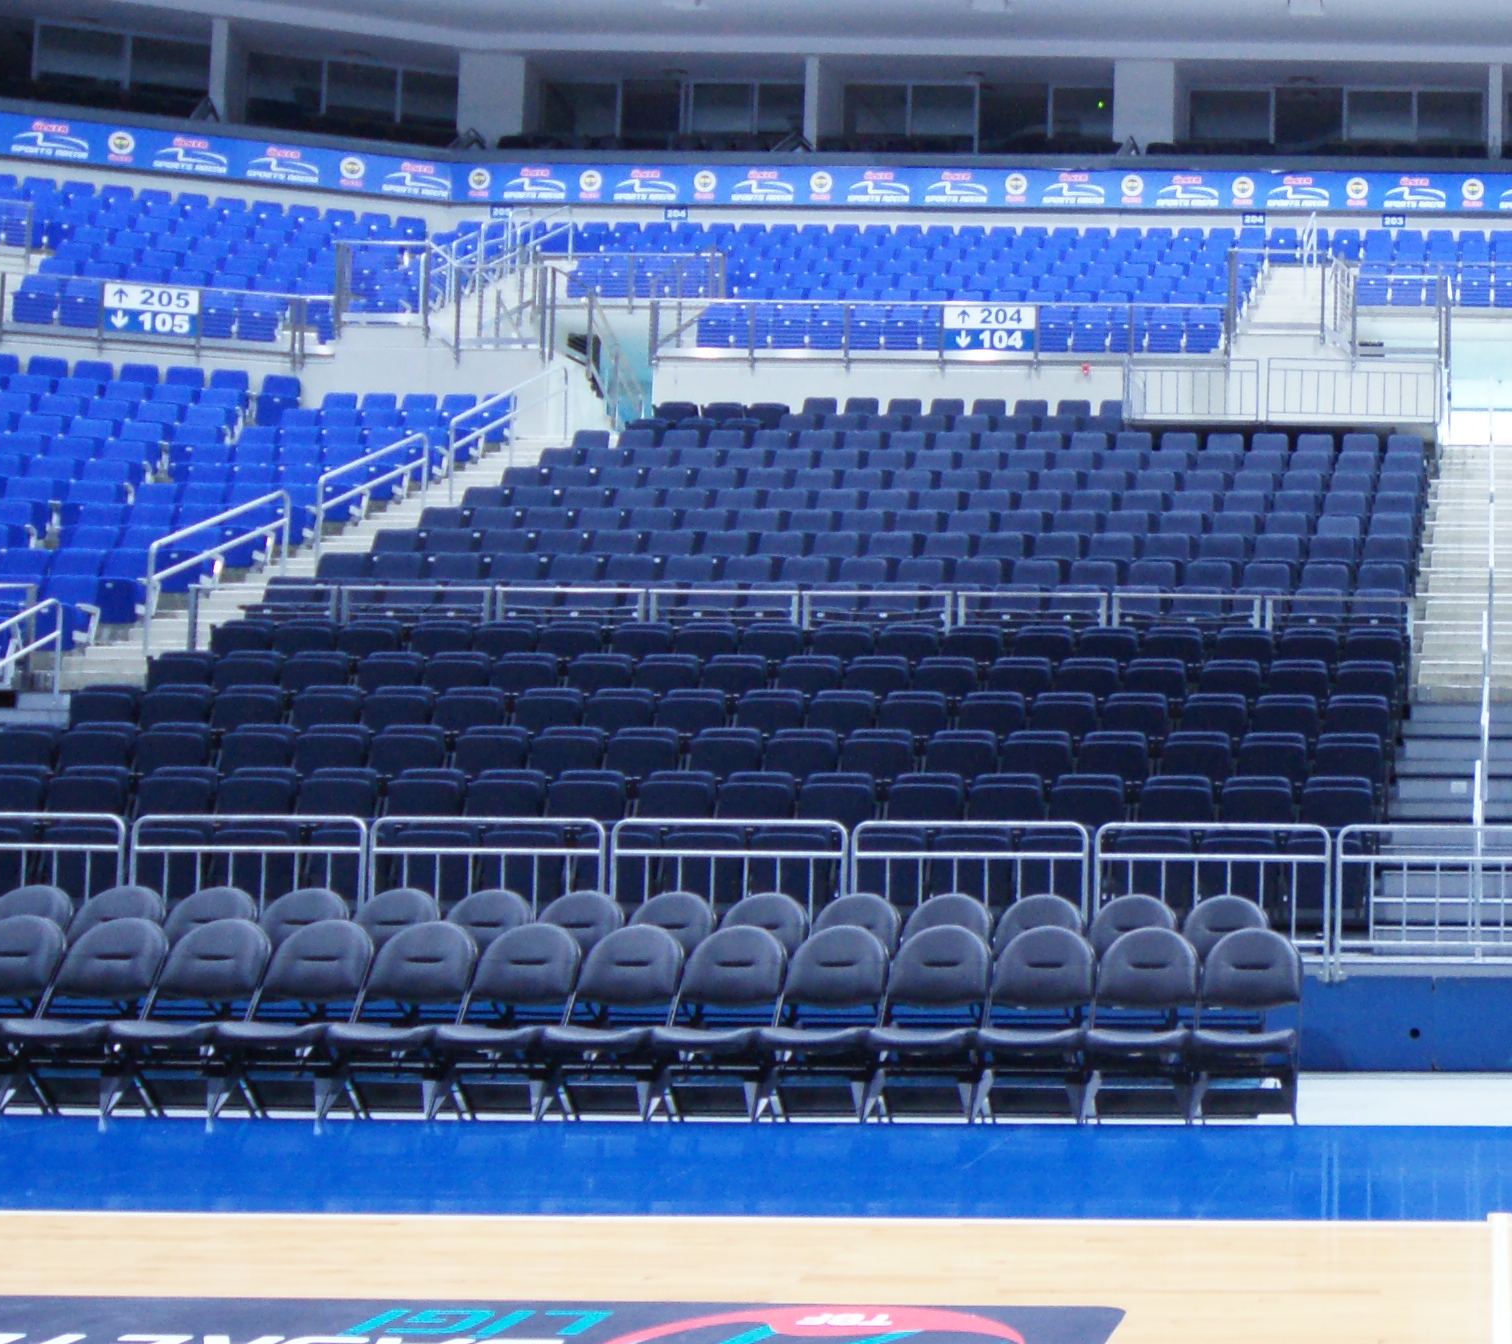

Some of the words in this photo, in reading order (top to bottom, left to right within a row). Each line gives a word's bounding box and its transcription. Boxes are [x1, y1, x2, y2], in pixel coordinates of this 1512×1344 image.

[140, 289, 189, 308] 205
[139, 312, 189, 333] 105
[979, 308, 1022, 324] 204
[979, 330, 1023, 349] 104
